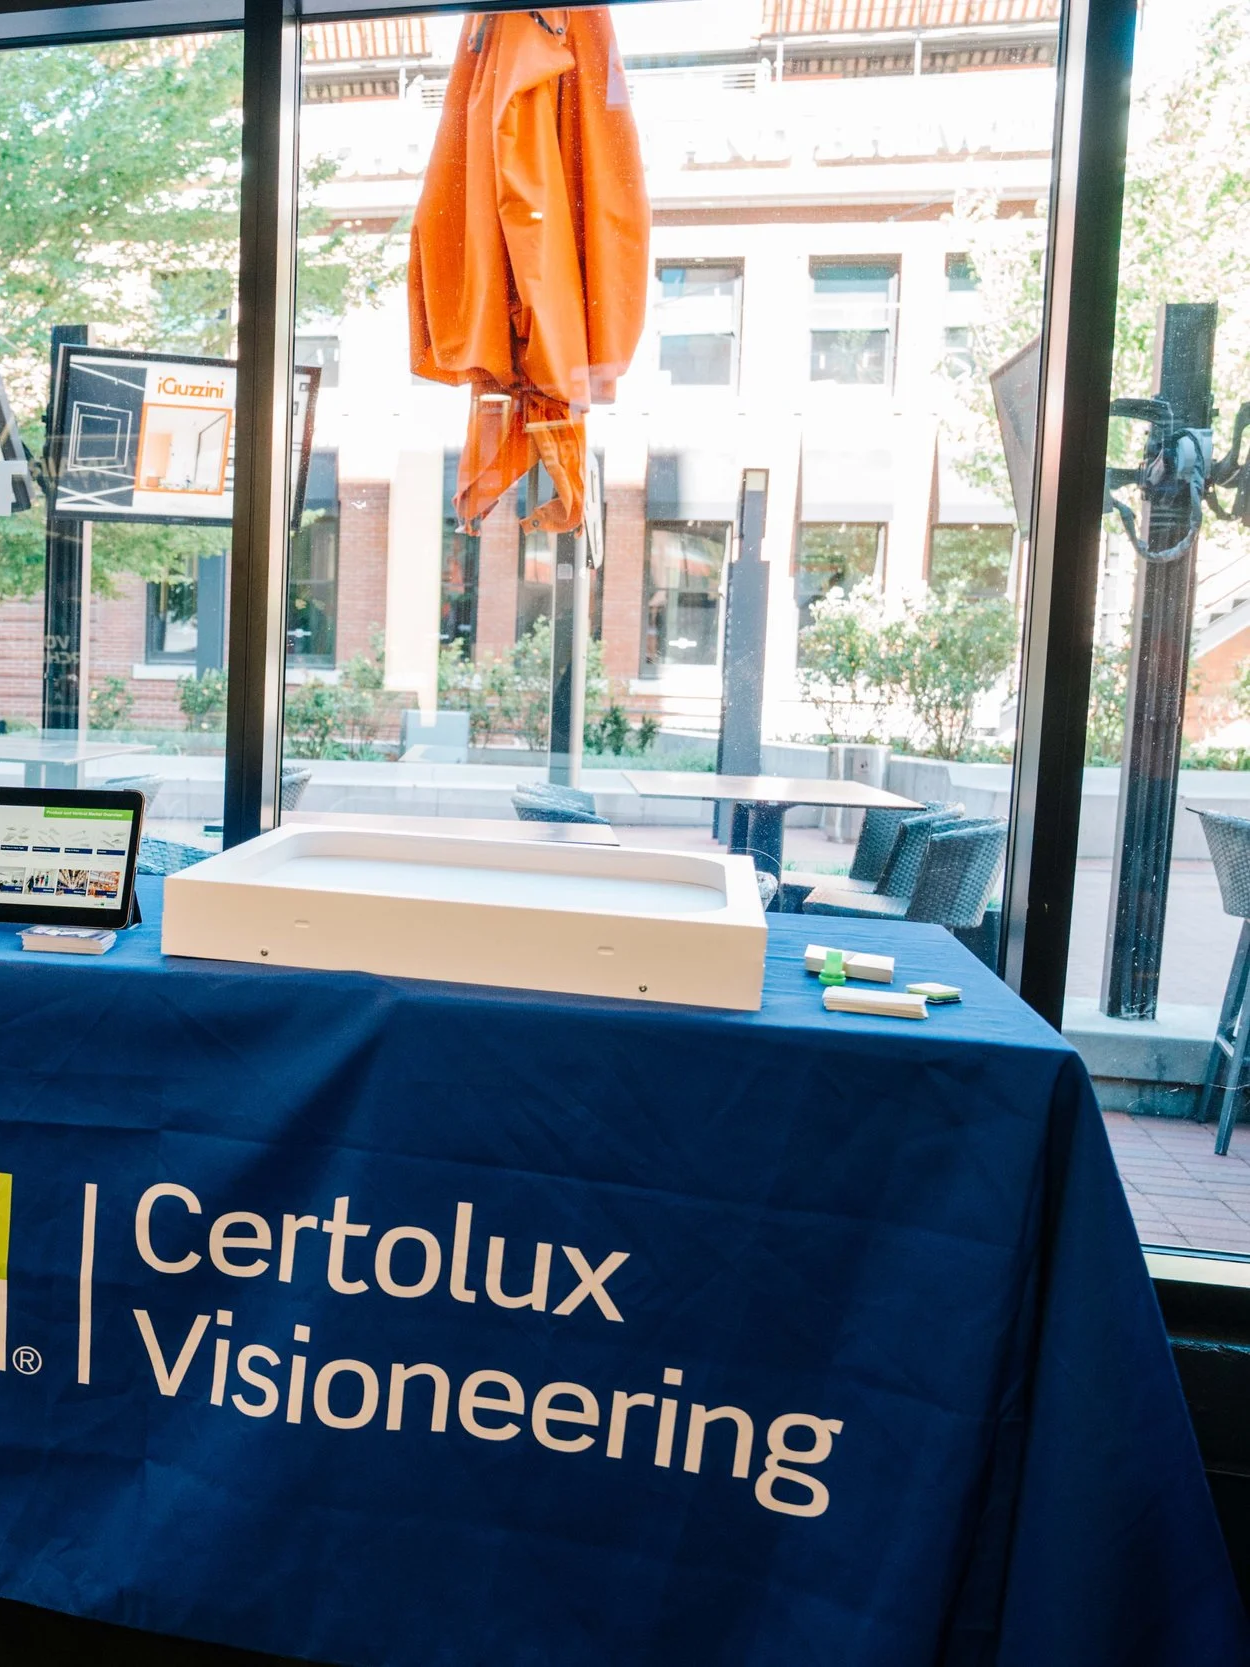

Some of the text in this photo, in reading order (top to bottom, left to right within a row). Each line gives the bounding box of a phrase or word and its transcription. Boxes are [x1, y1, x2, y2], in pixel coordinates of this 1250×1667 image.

[158, 376, 225, 399] iGuzzini
[134, 1181, 631, 1323] Certolux
[132, 1309, 844, 1518] Visioneering
